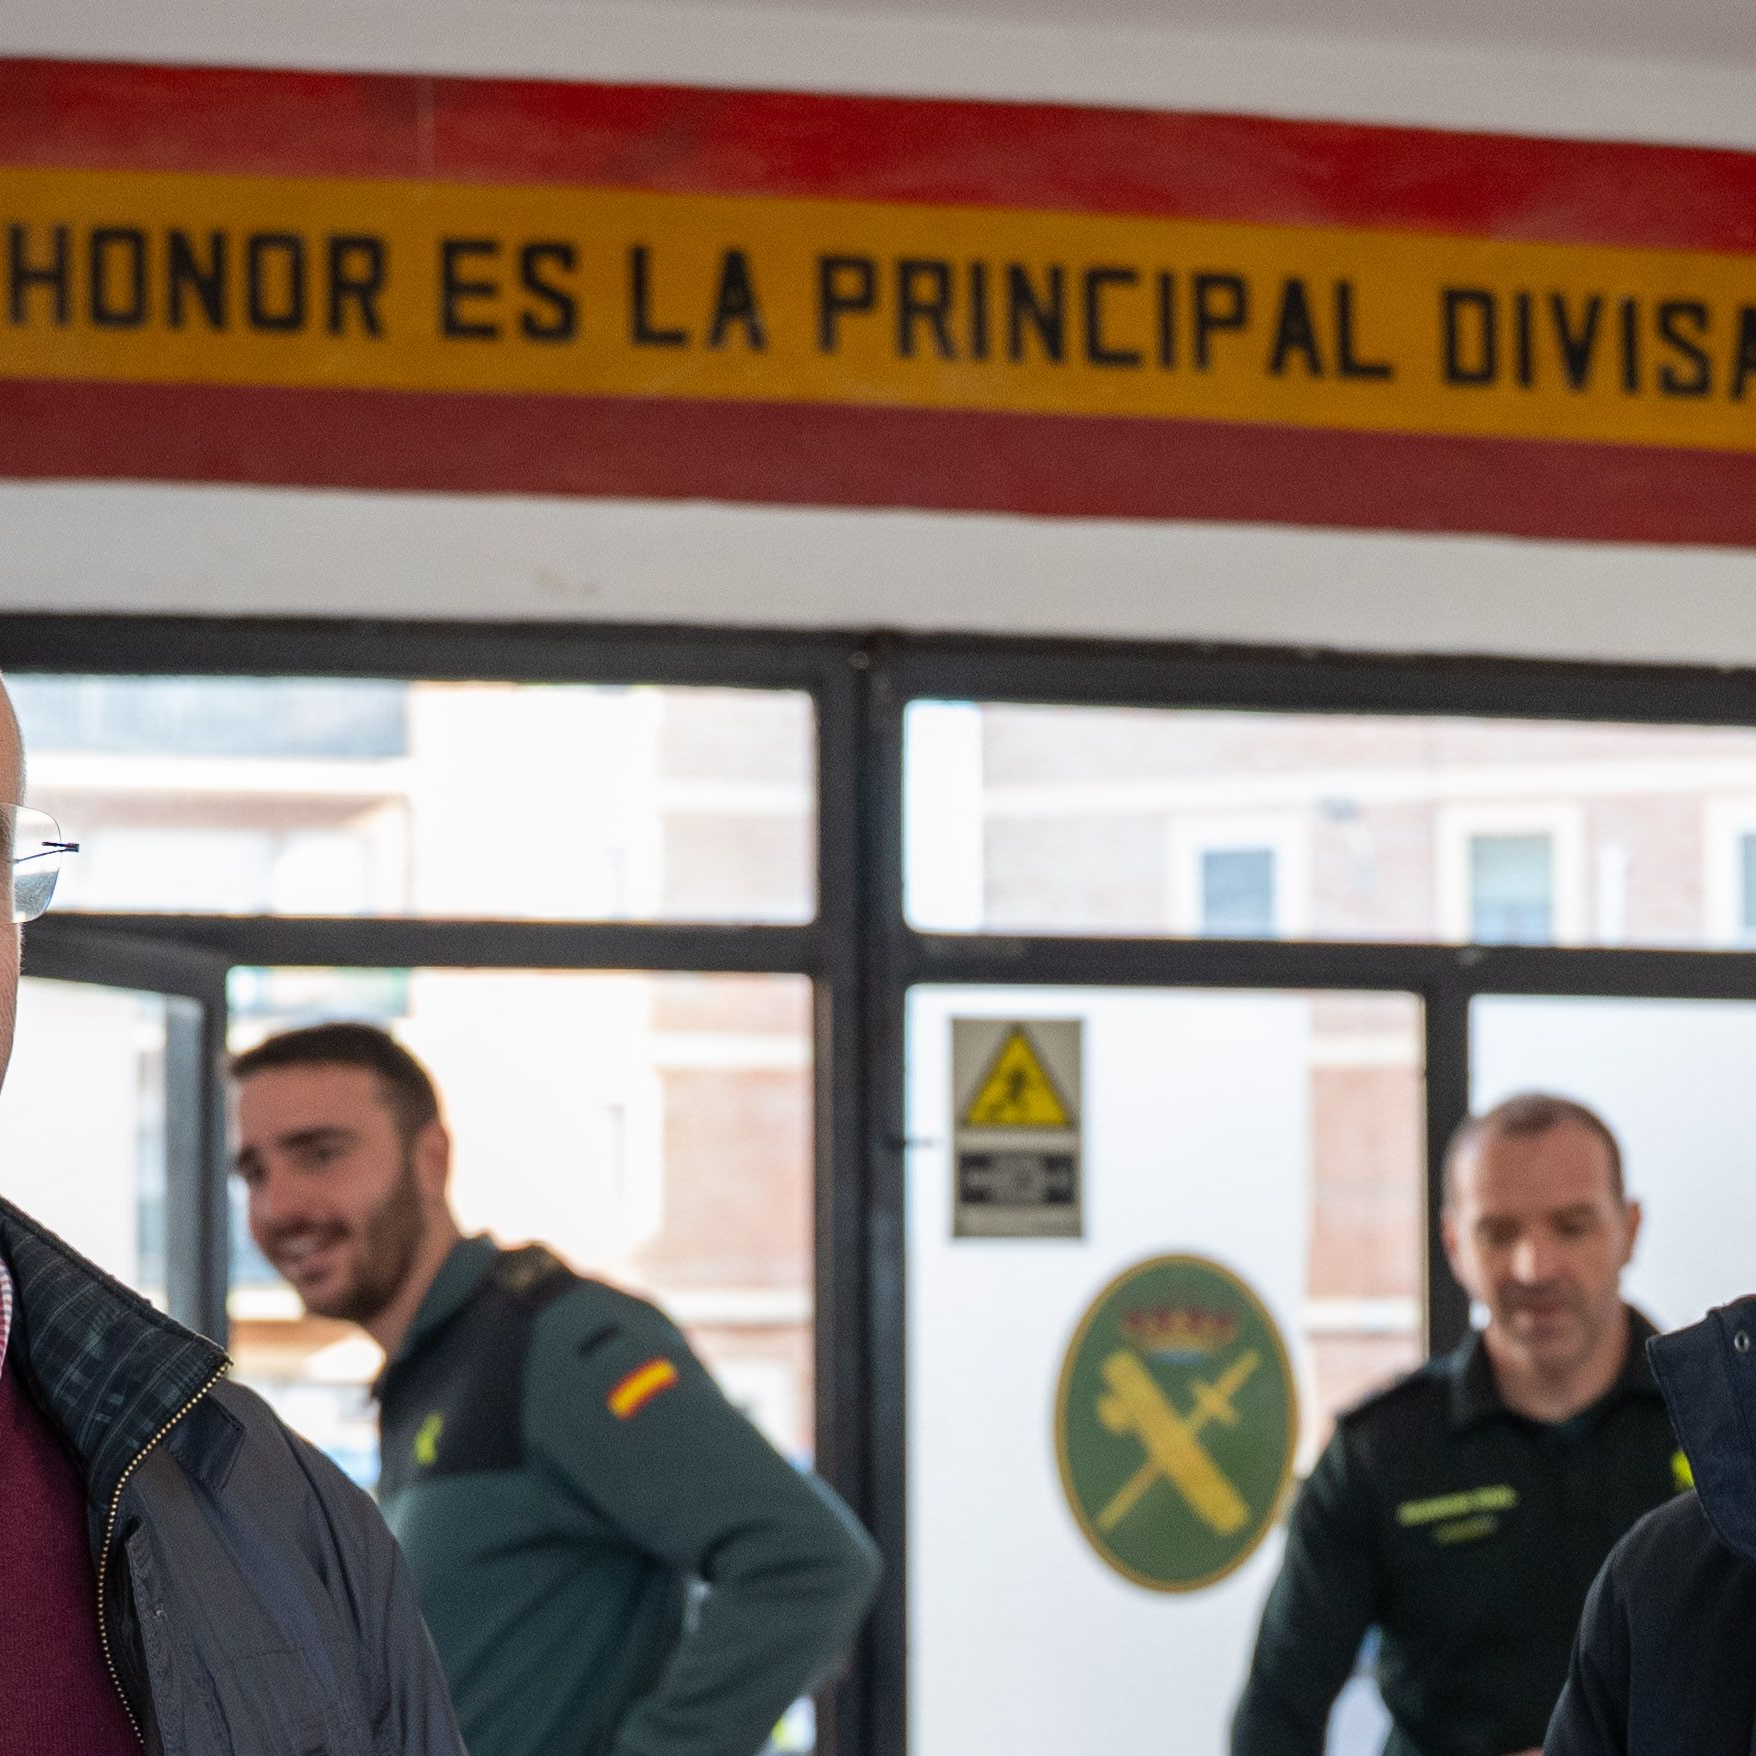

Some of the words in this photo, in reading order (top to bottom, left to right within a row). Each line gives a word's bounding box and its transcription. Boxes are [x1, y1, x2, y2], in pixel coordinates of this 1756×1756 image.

[5, 221, 390, 339] HONOR
[439, 238, 580, 345] ES
[627, 244, 767, 352] LA
[815, 252, 1395, 382] PRINCIPAL
